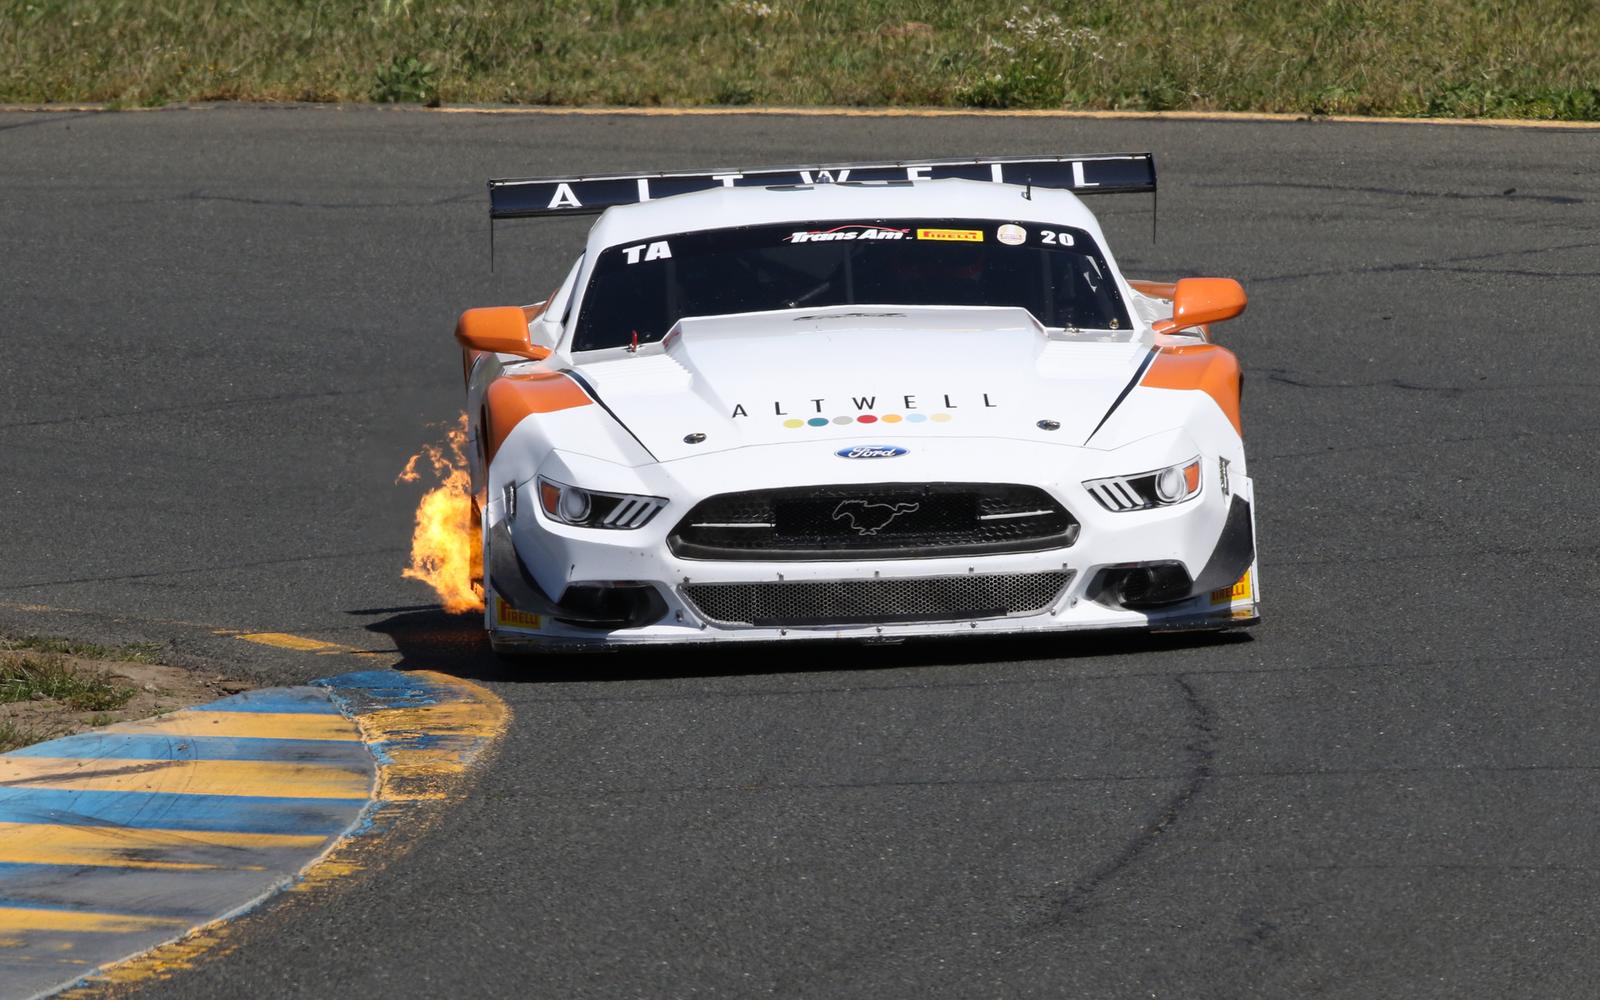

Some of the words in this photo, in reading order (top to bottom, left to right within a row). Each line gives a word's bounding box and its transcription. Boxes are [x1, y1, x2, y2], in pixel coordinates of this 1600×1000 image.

[791, 231, 858, 243] Trans
[1040, 230, 1075, 247] 20
[622, 241, 672, 264] TA
[732, 393, 997, 418] ALTWELL
[848, 446, 897, 458] Ford
